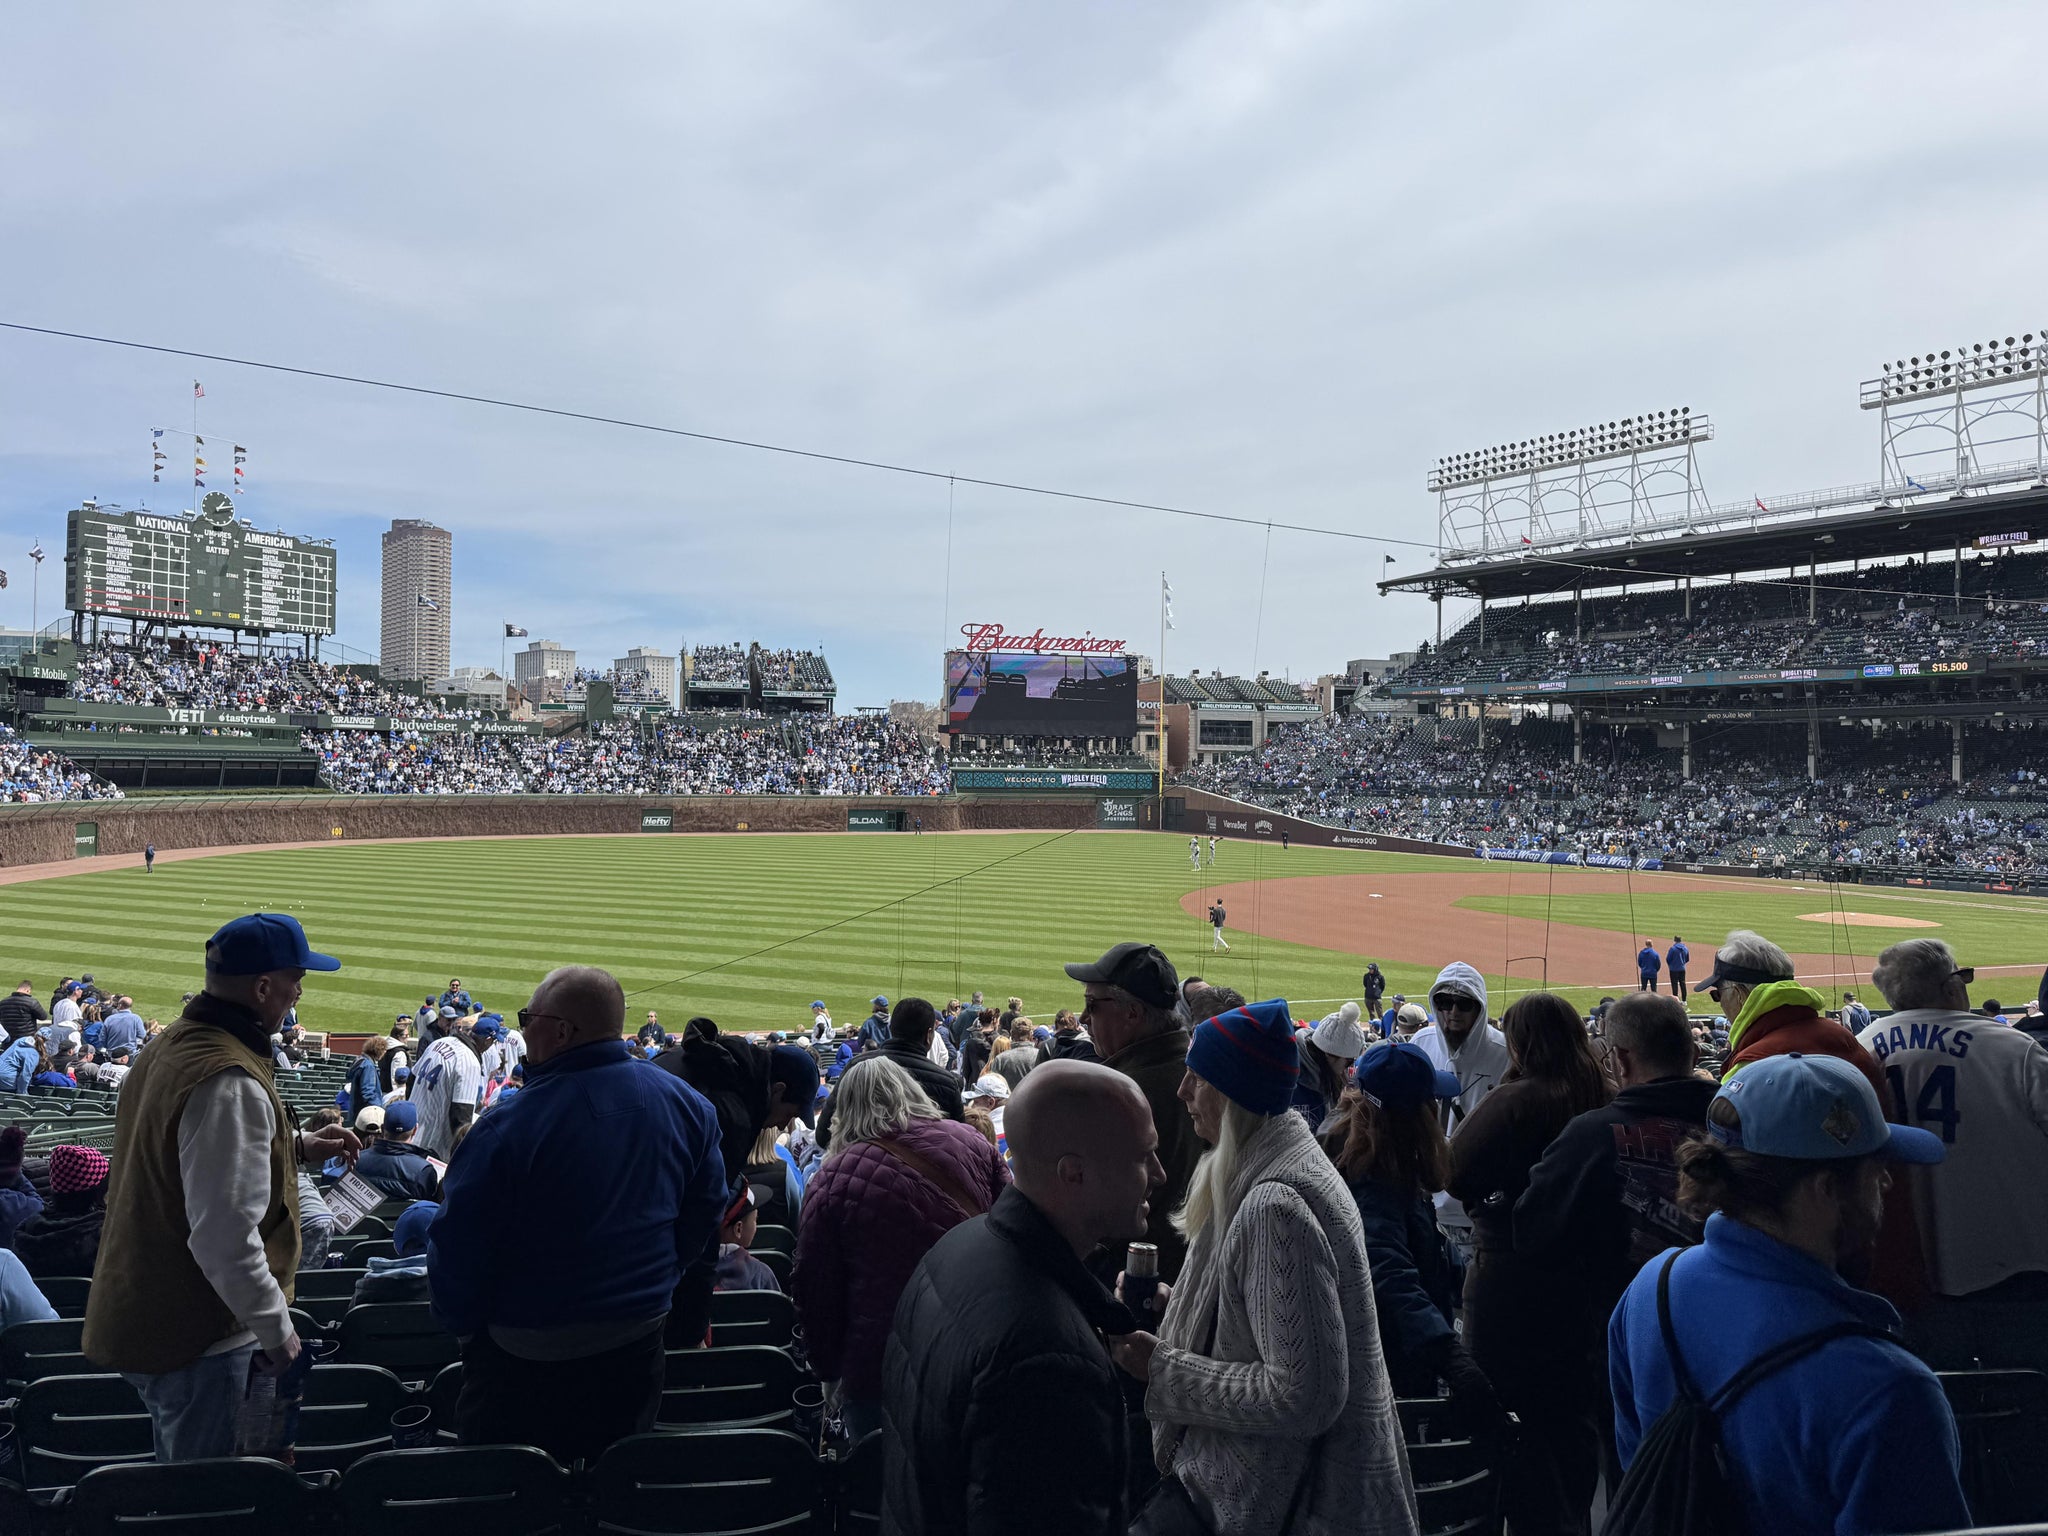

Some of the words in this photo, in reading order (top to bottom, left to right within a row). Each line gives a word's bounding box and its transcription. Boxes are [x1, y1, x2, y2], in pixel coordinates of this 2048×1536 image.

[136, 516, 190, 534] NATIONAL
[204, 529, 232, 540] UMPIRES
[1979, 534, 2009, 545] WRIGLEY
[2010, 532, 2028, 540] FIELD
[244, 533, 293, 549] AMERICAN
[206, 546, 230, 555] BATTER
[960, 623, 1126, 652] Budweiser
[1932, 662, 1968, 672] $15,500
[42, 668, 67, 680] Mobile
[1781, 670, 1803, 678] WRIGLEY
[1650, 676, 1670, 684] WRIGLEY
[1137, 700, 1162, 709] oore
[168, 708, 206, 722] YETI
[226, 713, 276, 724] tastytrade
[332, 716, 375, 725] GRAINGER
[390, 718, 457, 731] Budweiser
[484, 722, 528, 732] Advocate
[1061, 774, 1089, 784] WRIGLEY
[1090, 775, 1107, 785] FIELD
[645, 817, 669, 826] Hefty
[332, 827, 342, 836] 400
[1342, 835, 1363, 844] Invesco
[1487, 850, 1517, 859] eynolds
[1517, 850, 1540, 861] Wrap
[1686, 863, 1703, 871] meijer
[1872, 1023, 1973, 1060] BANKS
[433, 1042, 455, 1059] RIZZO
[416, 1058, 443, 1092] 44
[1886, 1064, 1960, 1144] 14
[349, 1177, 366, 1192] FIRST
[364, 1189, 377, 1200] TIME
